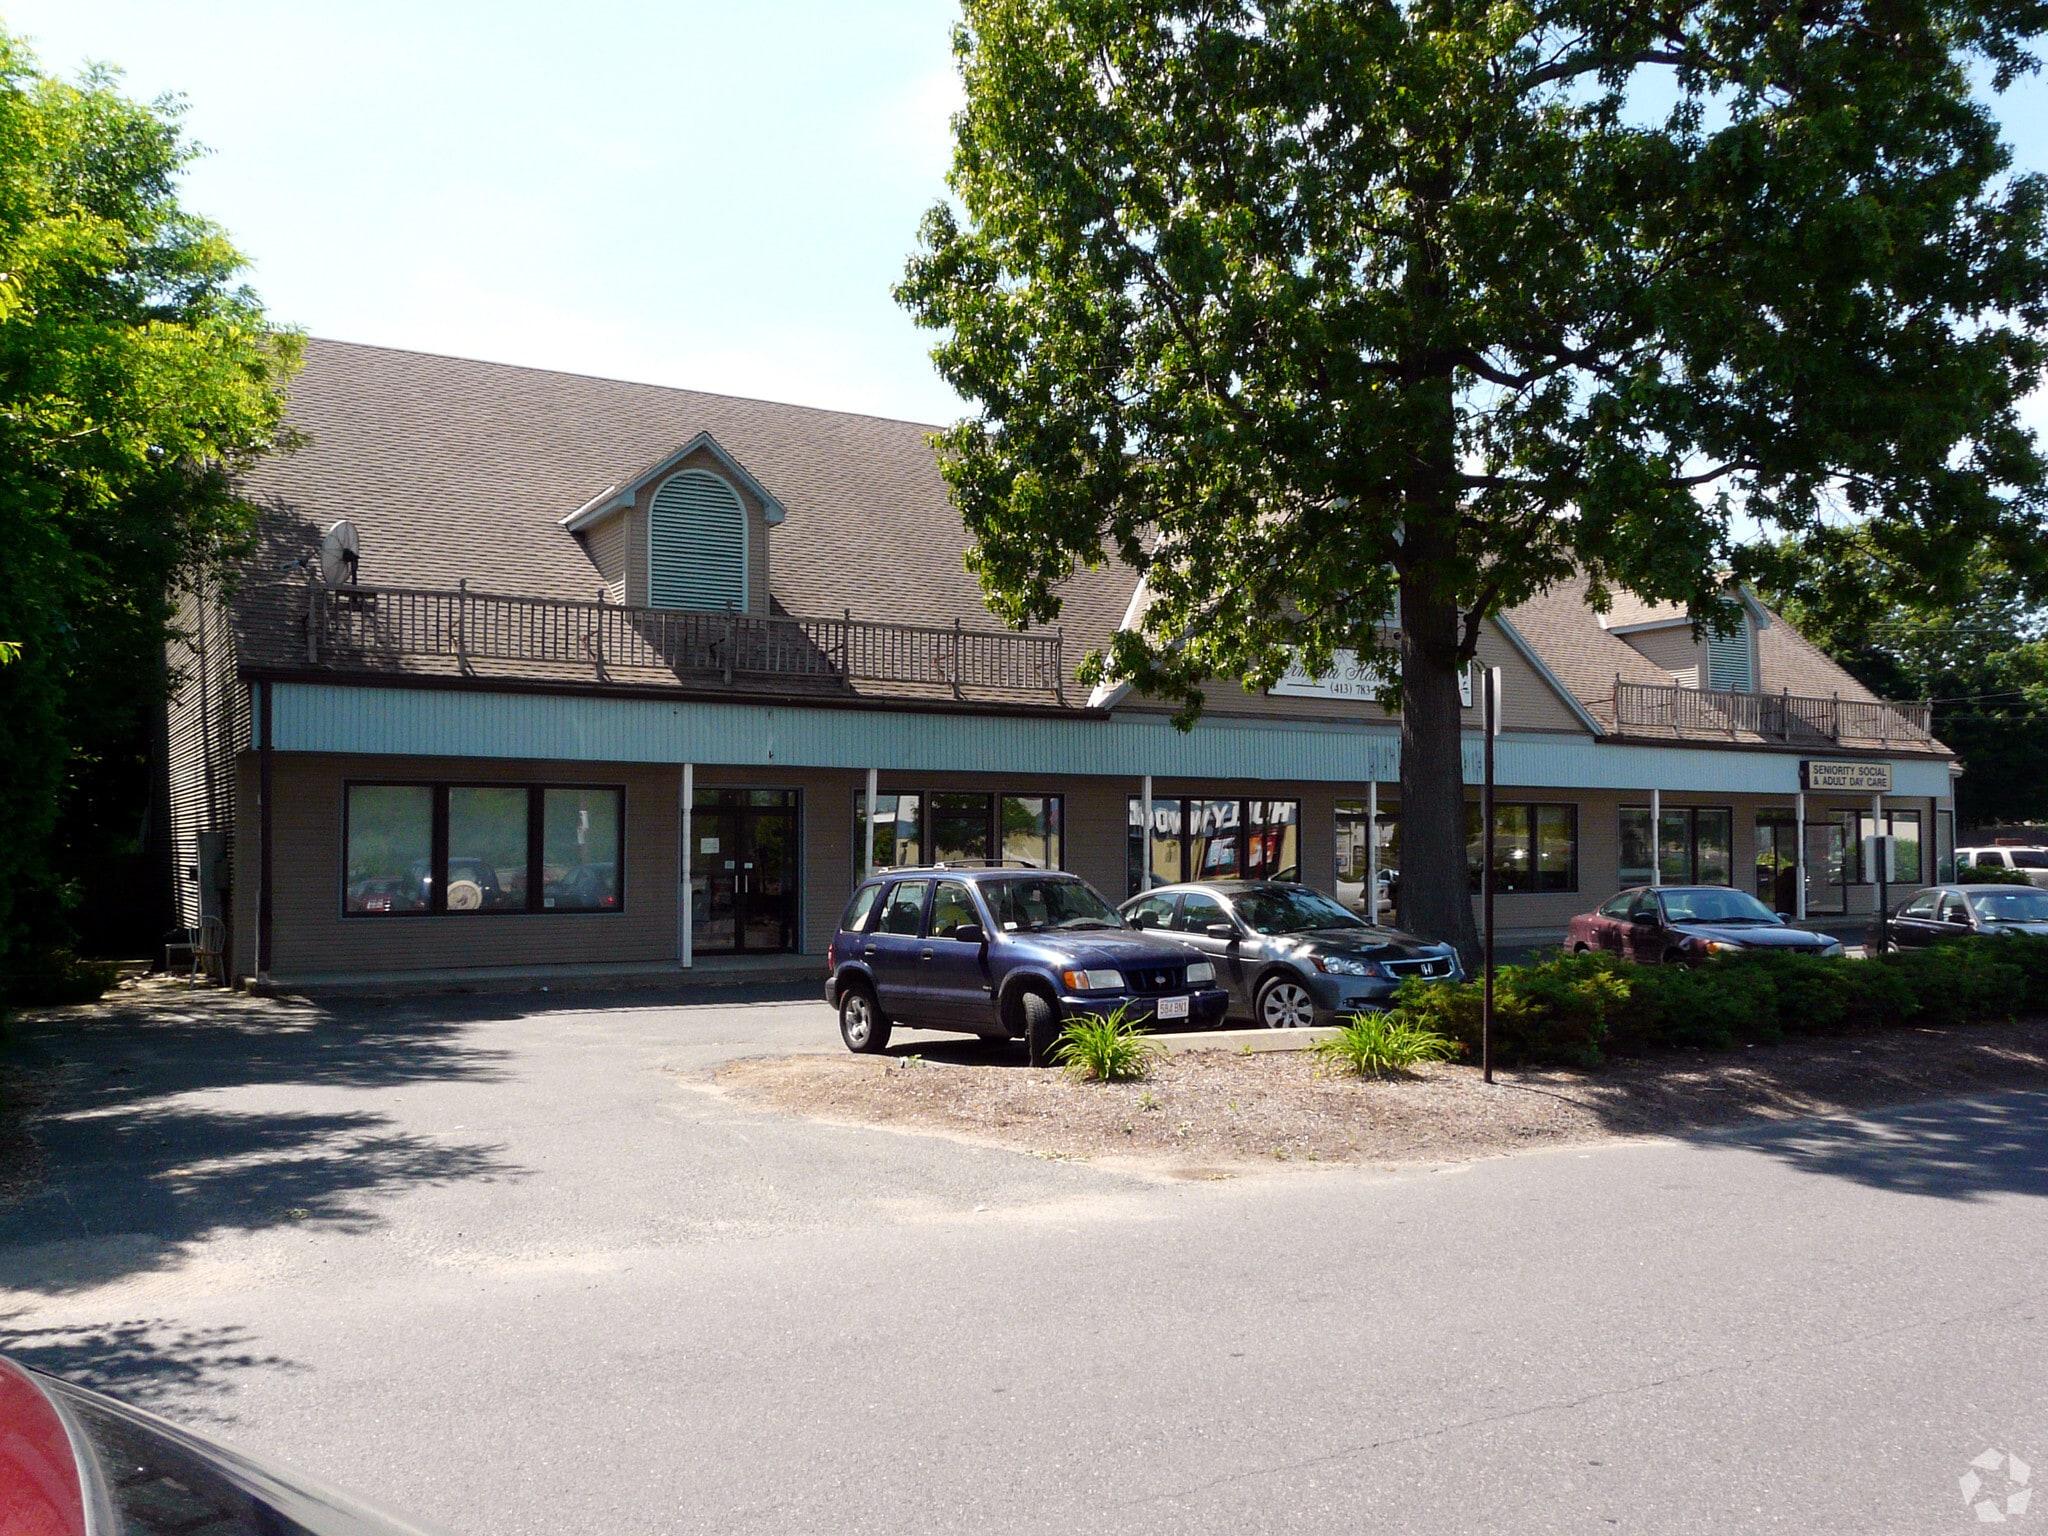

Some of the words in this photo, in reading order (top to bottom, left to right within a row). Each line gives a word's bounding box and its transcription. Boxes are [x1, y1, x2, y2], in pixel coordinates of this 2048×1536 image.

[1330, 682, 1353, 695] (413)
[1813, 764, 1855, 775] SENIORITY
[1858, 766, 1887, 776] SOCIAL
[1814, 776, 1819, 785] &
[1823, 776, 1846, 786] ADULT
[1850, 777, 1864, 786] DAY
[1867, 777, 1888, 787] CARE
